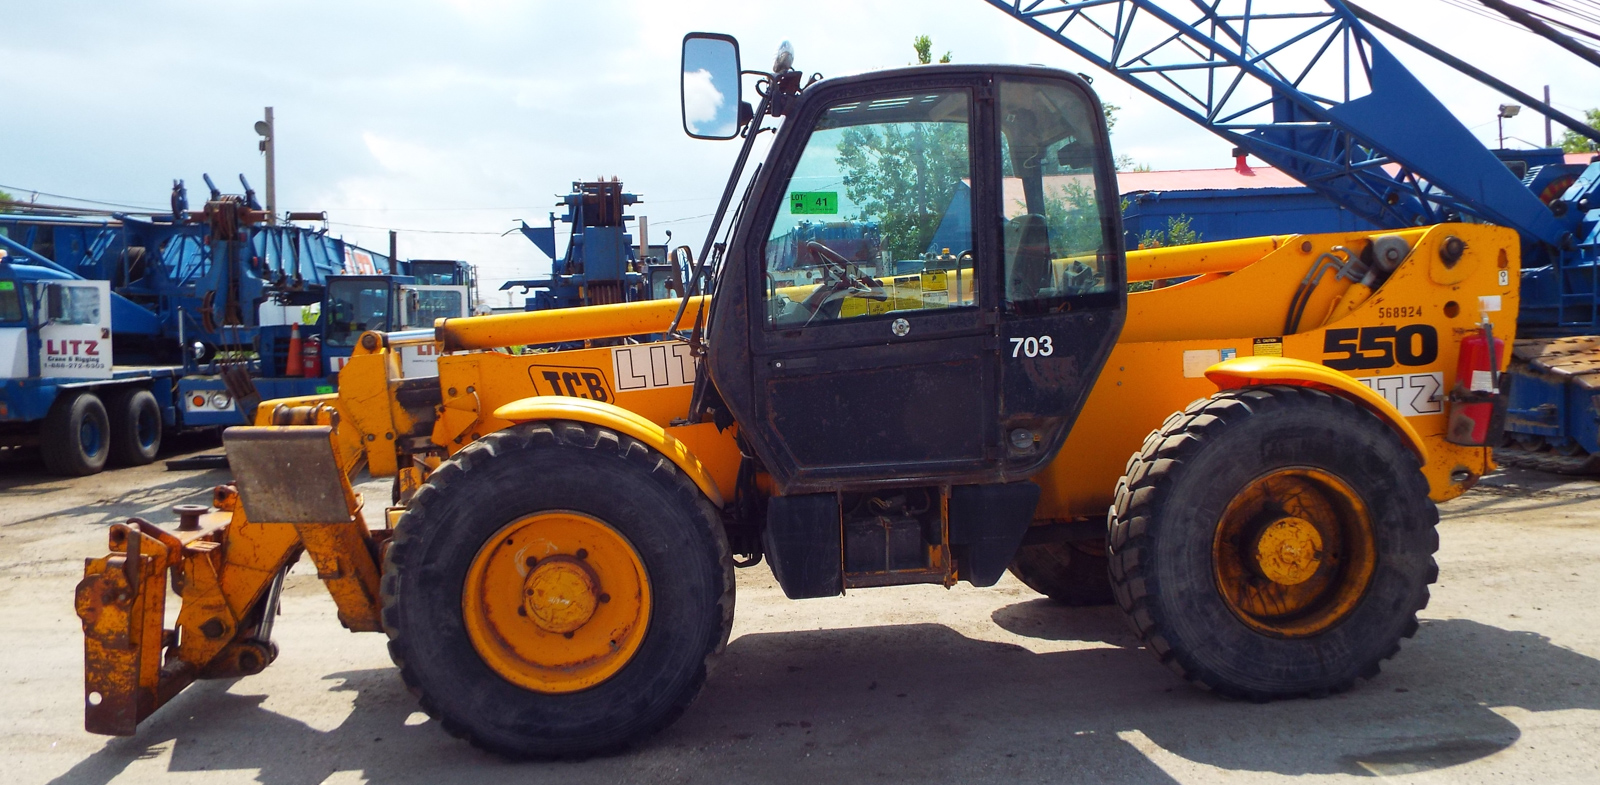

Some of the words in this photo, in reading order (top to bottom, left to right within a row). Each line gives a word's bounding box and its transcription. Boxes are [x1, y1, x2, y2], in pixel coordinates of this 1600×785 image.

[815, 197, 828, 206] 41
[1378, 306, 1423, 319] 568924
[47, 339, 99, 355] LITZ
[1009, 335, 1054, 358] 703
[1322, 324, 1438, 371] 550
[615, 344, 699, 390] LIT
[1357, 374, 1441, 413] TZ
